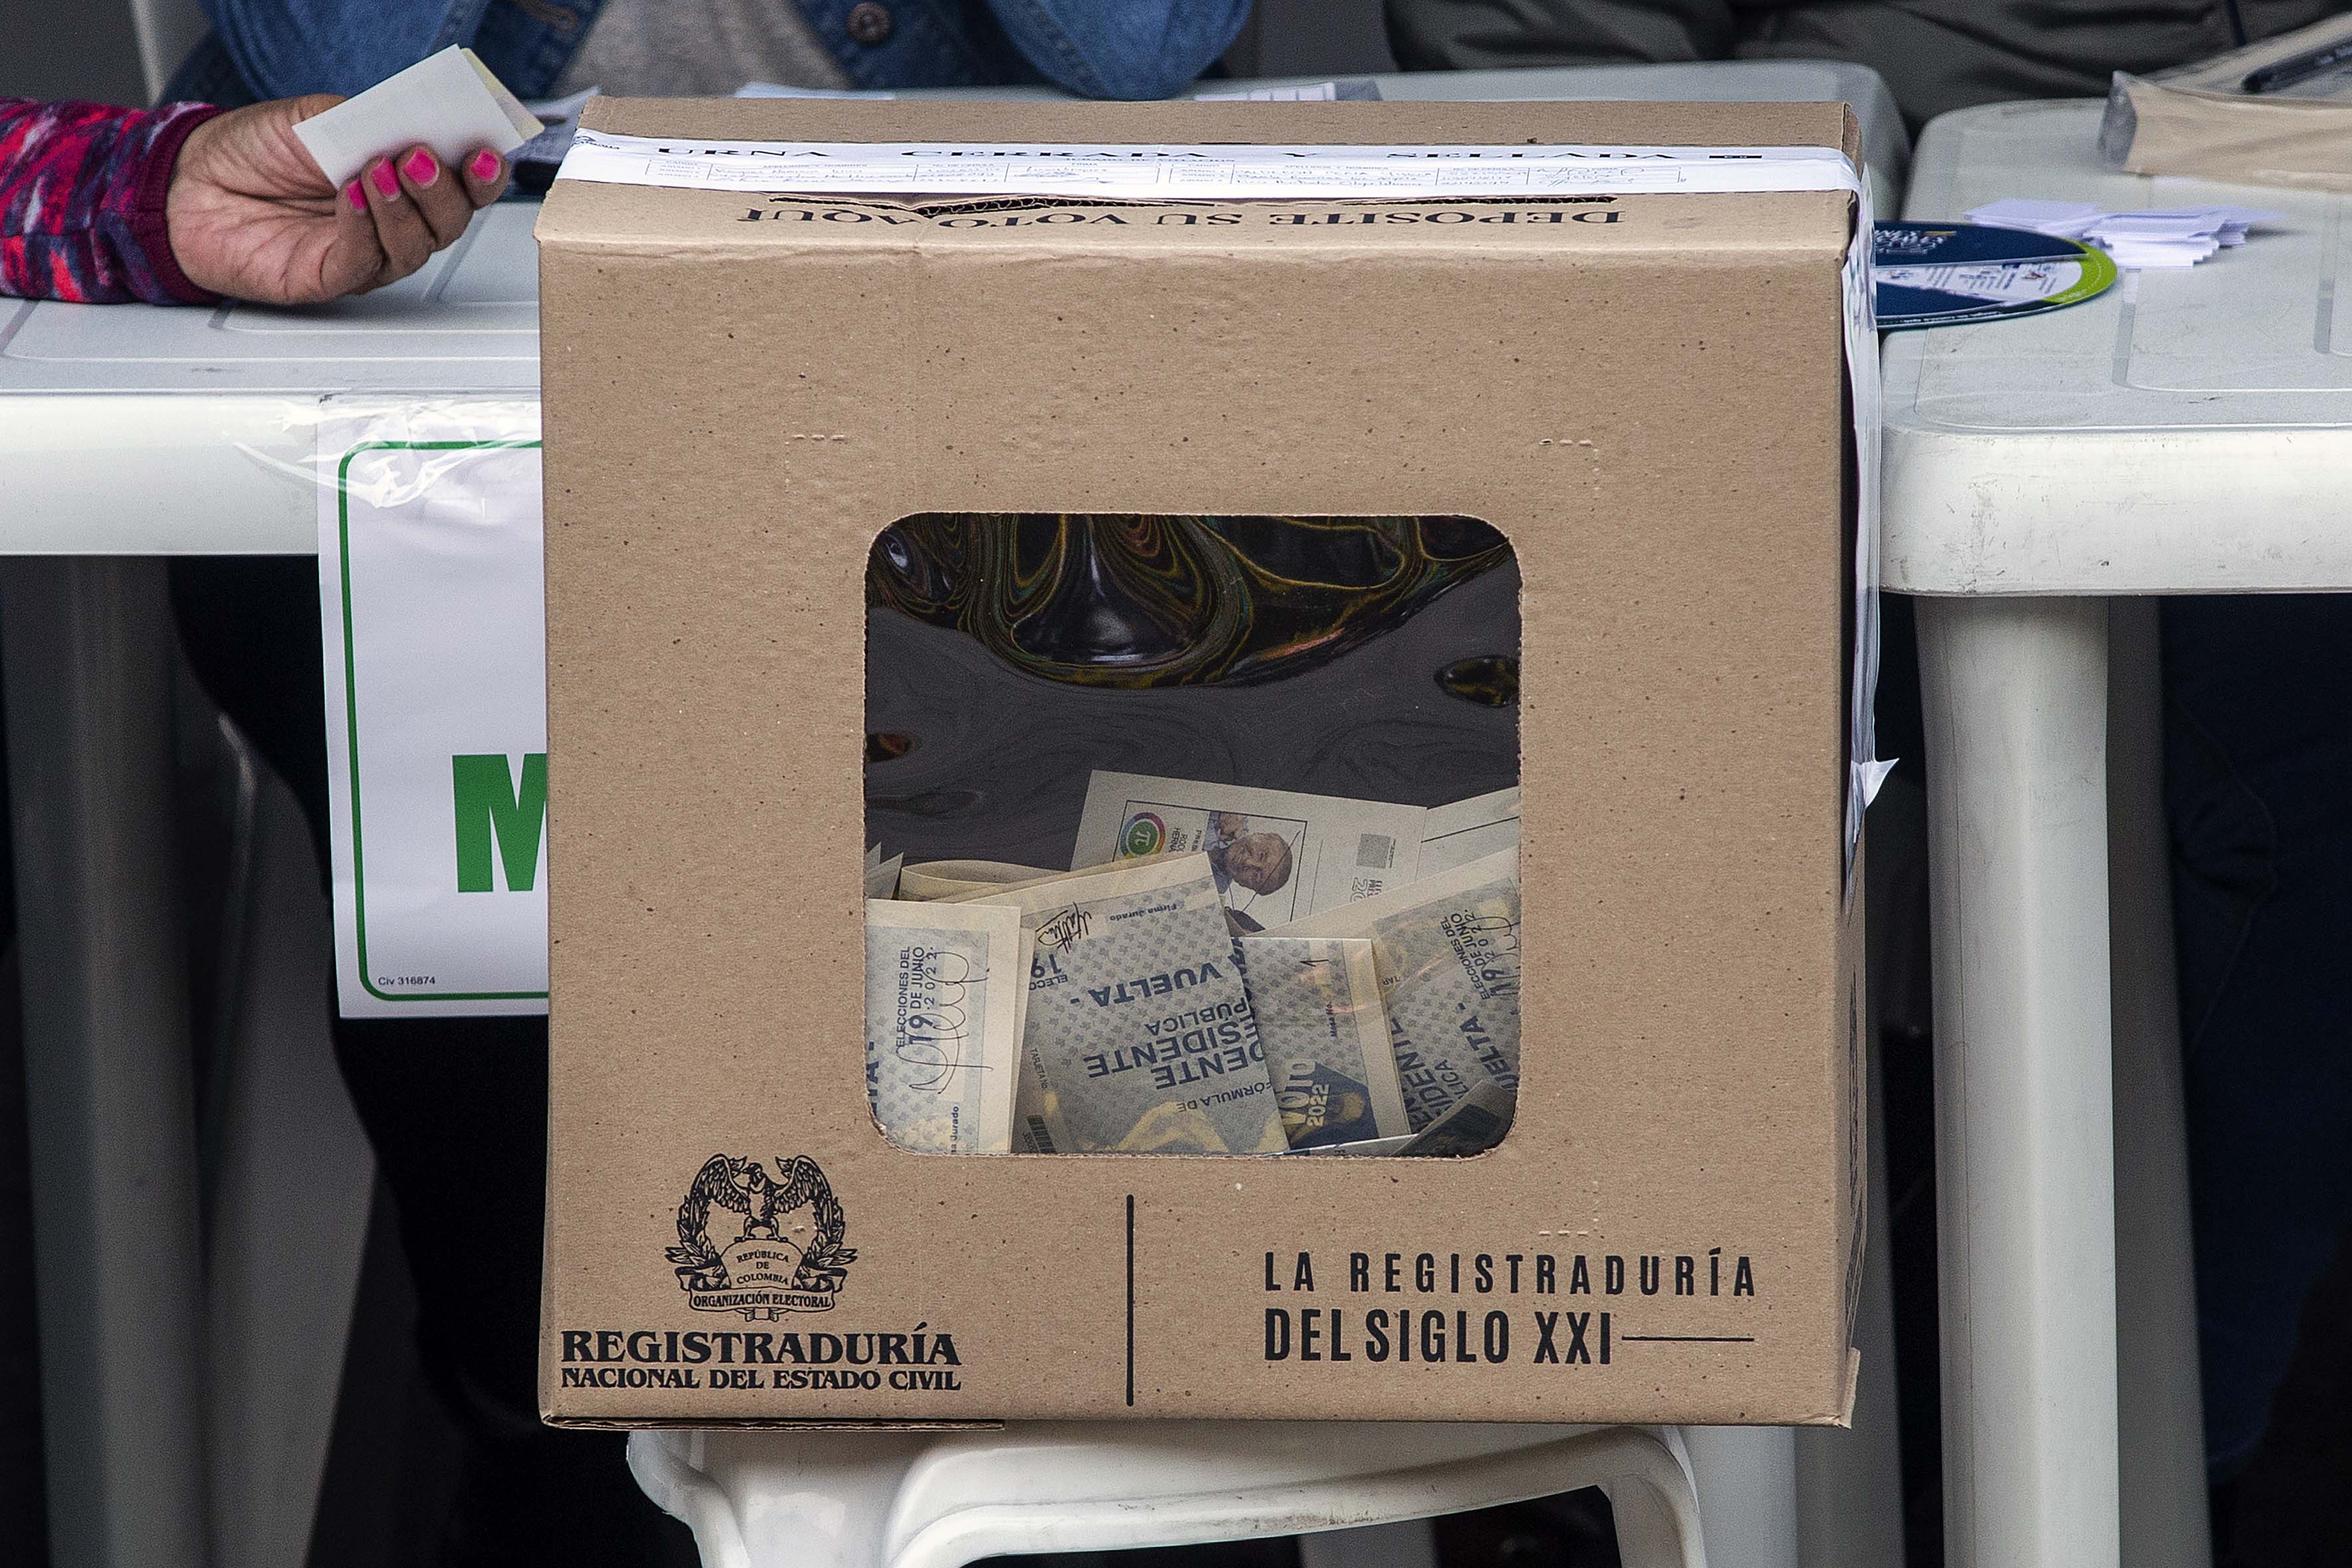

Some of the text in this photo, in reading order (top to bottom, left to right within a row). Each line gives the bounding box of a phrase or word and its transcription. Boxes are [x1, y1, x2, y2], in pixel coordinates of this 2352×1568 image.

[657, 147, 830, 157] URNA
[937, 212, 1130, 229] VOTO
[1152, 212, 1244, 226] SU
[1268, 210, 1626, 226] DEPOSITE
[1449, 912, 1486, 967] DE JUNIO
[1440, 916, 1490, 1000] ELECCIONES DEL
[911, 946, 925, 1009] DE JUNIO
[1087, 962, 1223, 1008] VUELTA
[896, 946, 910, 1048] ELECCIONES DEL
[909, 1014, 935, 1045] 19
[1176, 1099, 1198, 1113] DE
[1305, 1083, 1330, 1127] 2022
[736, 1248, 790, 1263] REPÚBLICA
[755, 1261, 770, 1270] DE
[736, 1273, 789, 1285] COLOMBIA
[1265, 1247, 1756, 1297] LA REGISTRADURÍA
[692, 1291, 832, 1308] ORGANIZACIÓN ELECTORAL
[561, 1321, 963, 1366] REGISTRADURÍA
[1265, 1307, 1610, 1364] DEL SIGLO XXI
[561, 1367, 963, 1391] NACIONAL DEL ESTADO CIVIL
